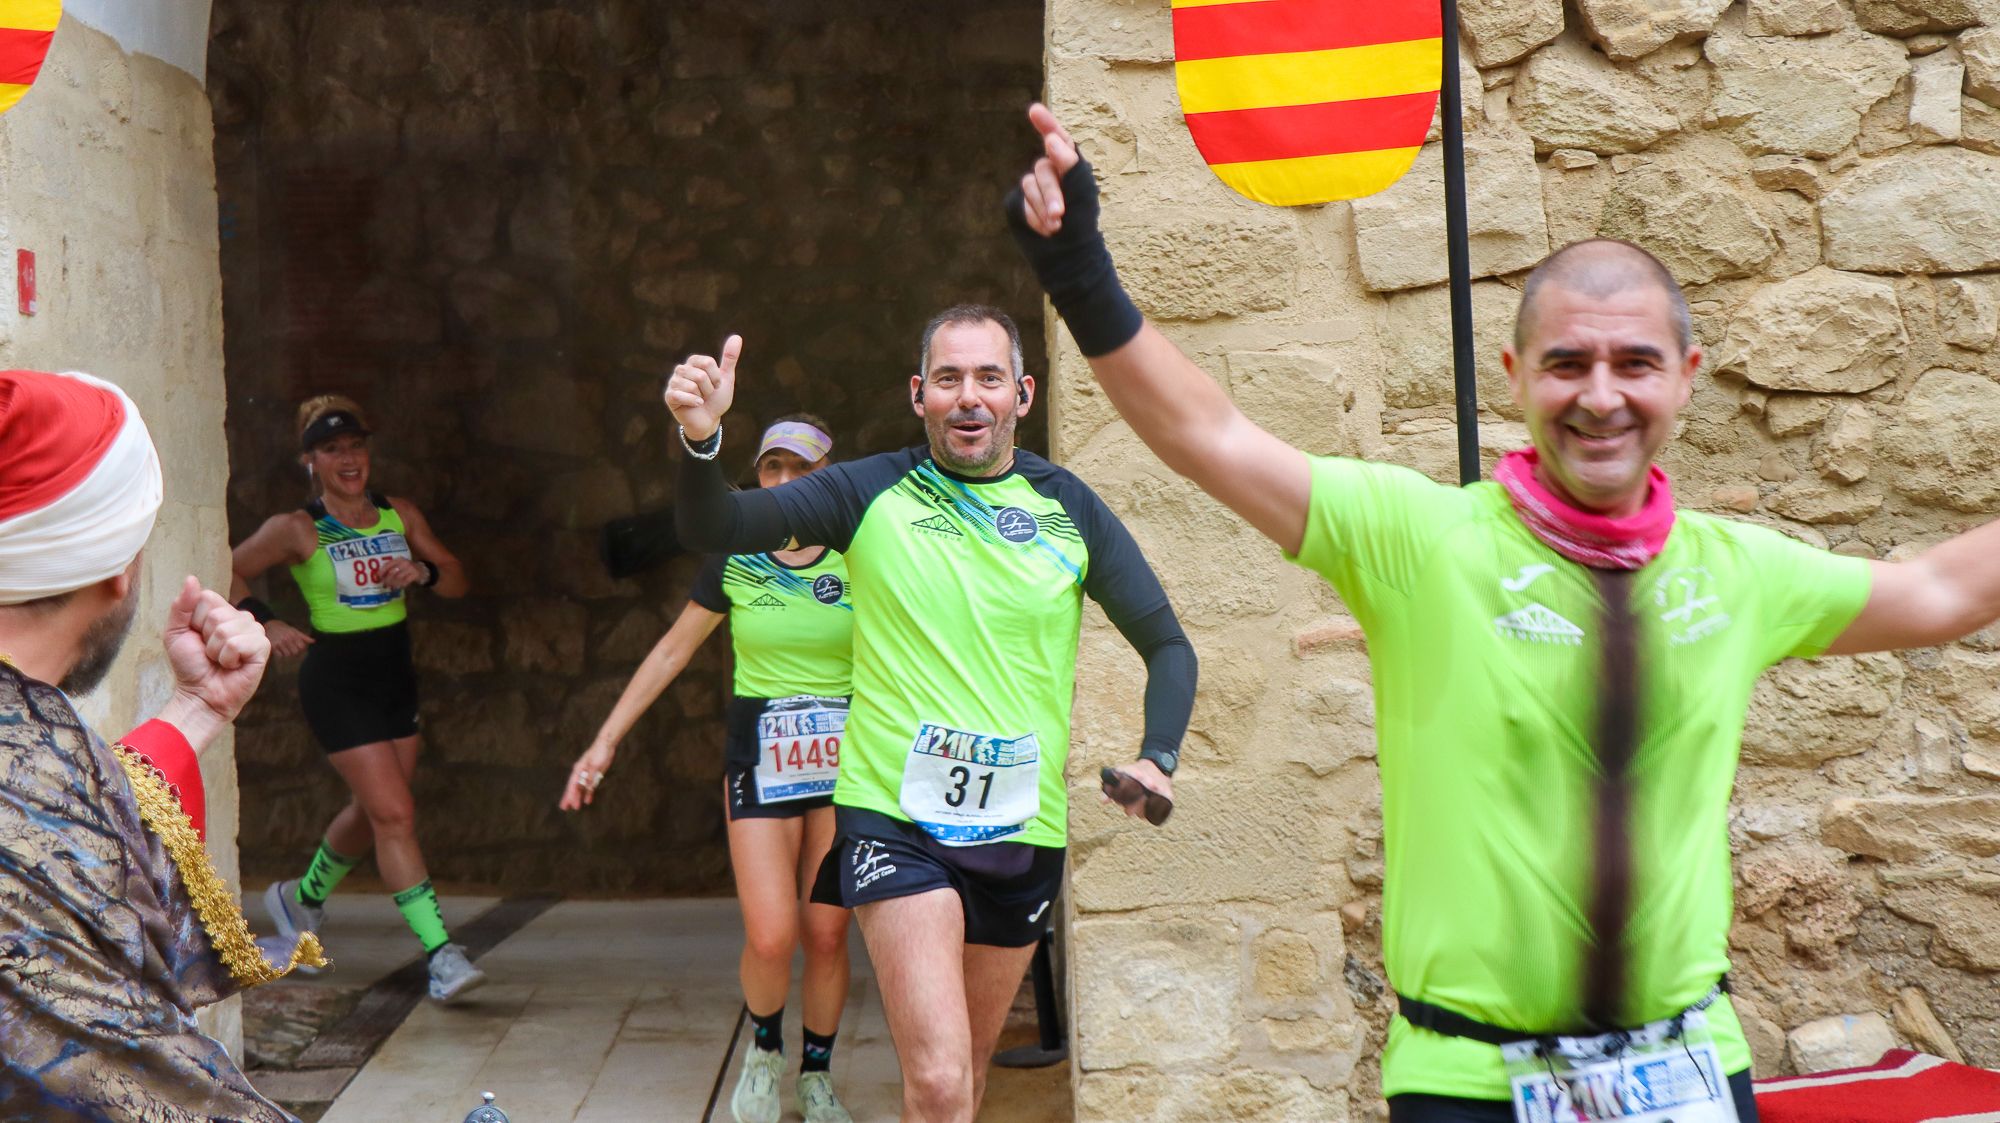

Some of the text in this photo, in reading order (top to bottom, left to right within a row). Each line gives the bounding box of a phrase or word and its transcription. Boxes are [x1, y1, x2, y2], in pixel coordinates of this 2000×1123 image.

[340, 540, 368, 559] 21K
[767, 715, 799, 738] 21K
[768, 736, 841, 773] 1449
[930, 727, 977, 762] 21K
[945, 765, 995, 810] 31
